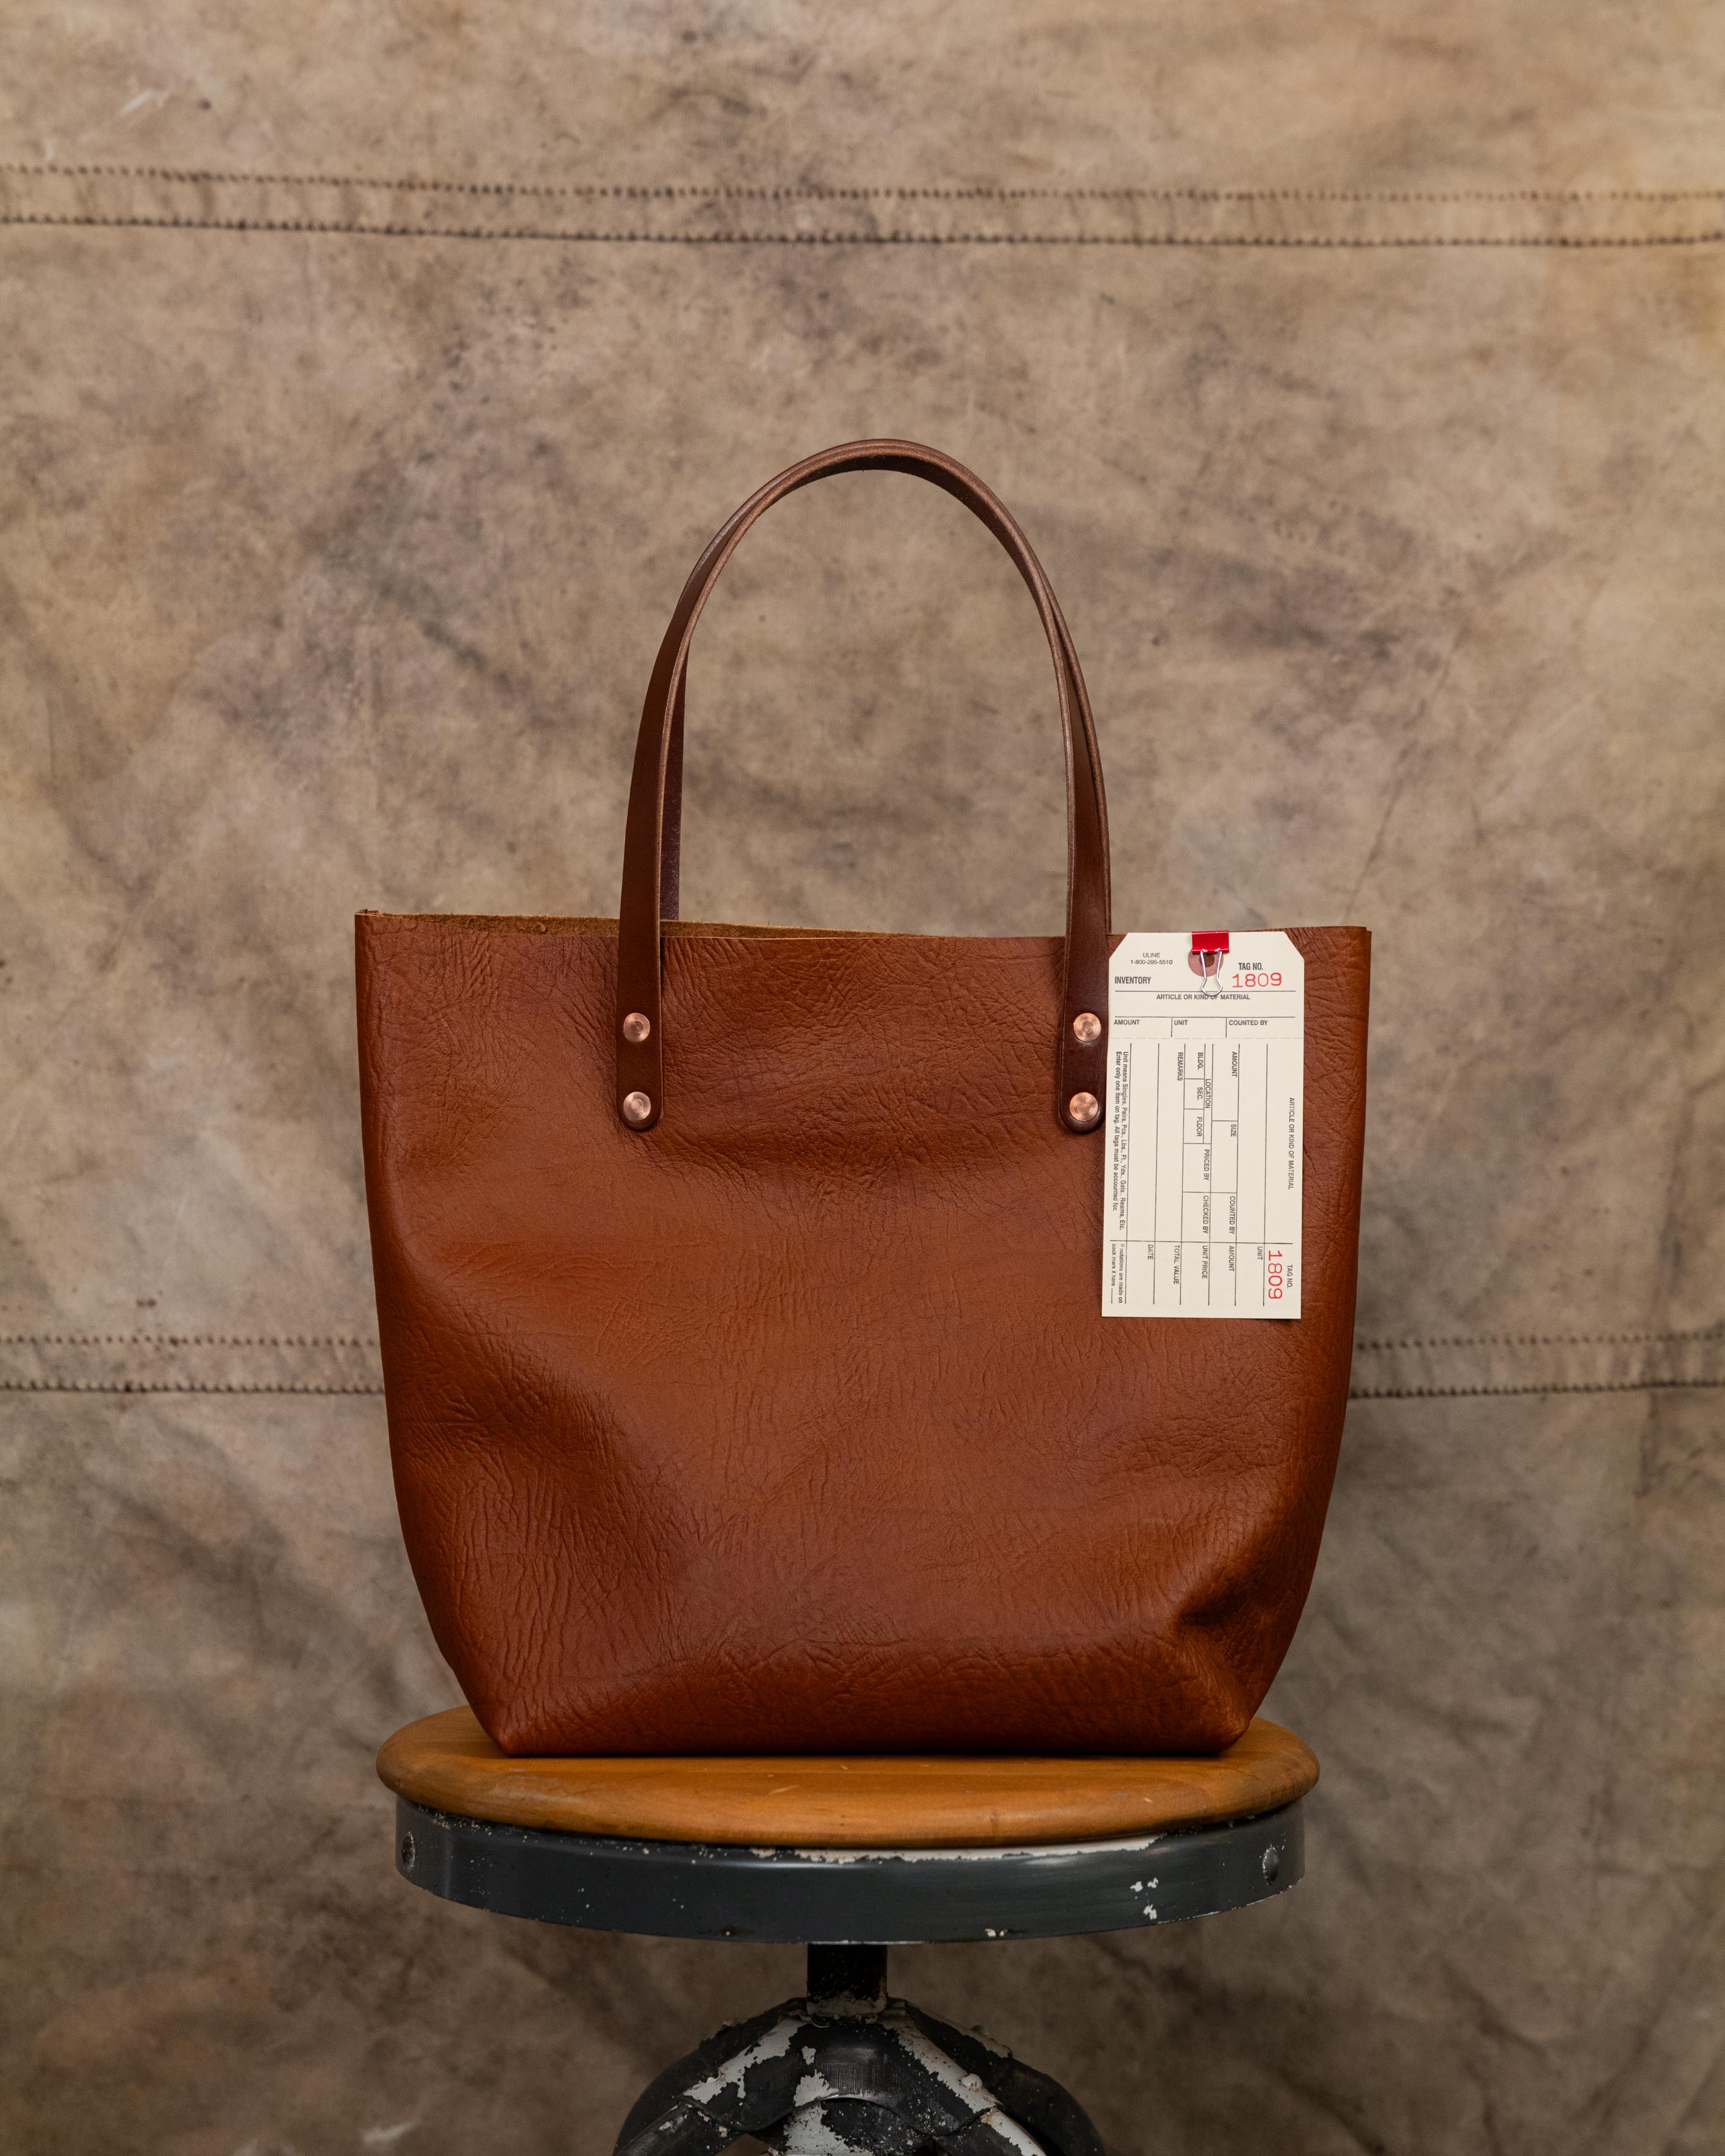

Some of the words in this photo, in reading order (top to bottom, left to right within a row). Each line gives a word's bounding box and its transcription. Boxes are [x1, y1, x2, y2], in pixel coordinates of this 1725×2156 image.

[1238, 962, 1251, 971] TAG
[1252, 962, 1263, 970] NO.
[1114, 976, 1152, 984] INVENTORY
[1232, 972, 1282, 988] 1809
[1288, 1123, 1295, 1133] OR
[1288, 1150, 1294, 1159] OF
[1229, 1226, 1235, 1234] BY
[1268, 1250, 1283, 1299] 1809
